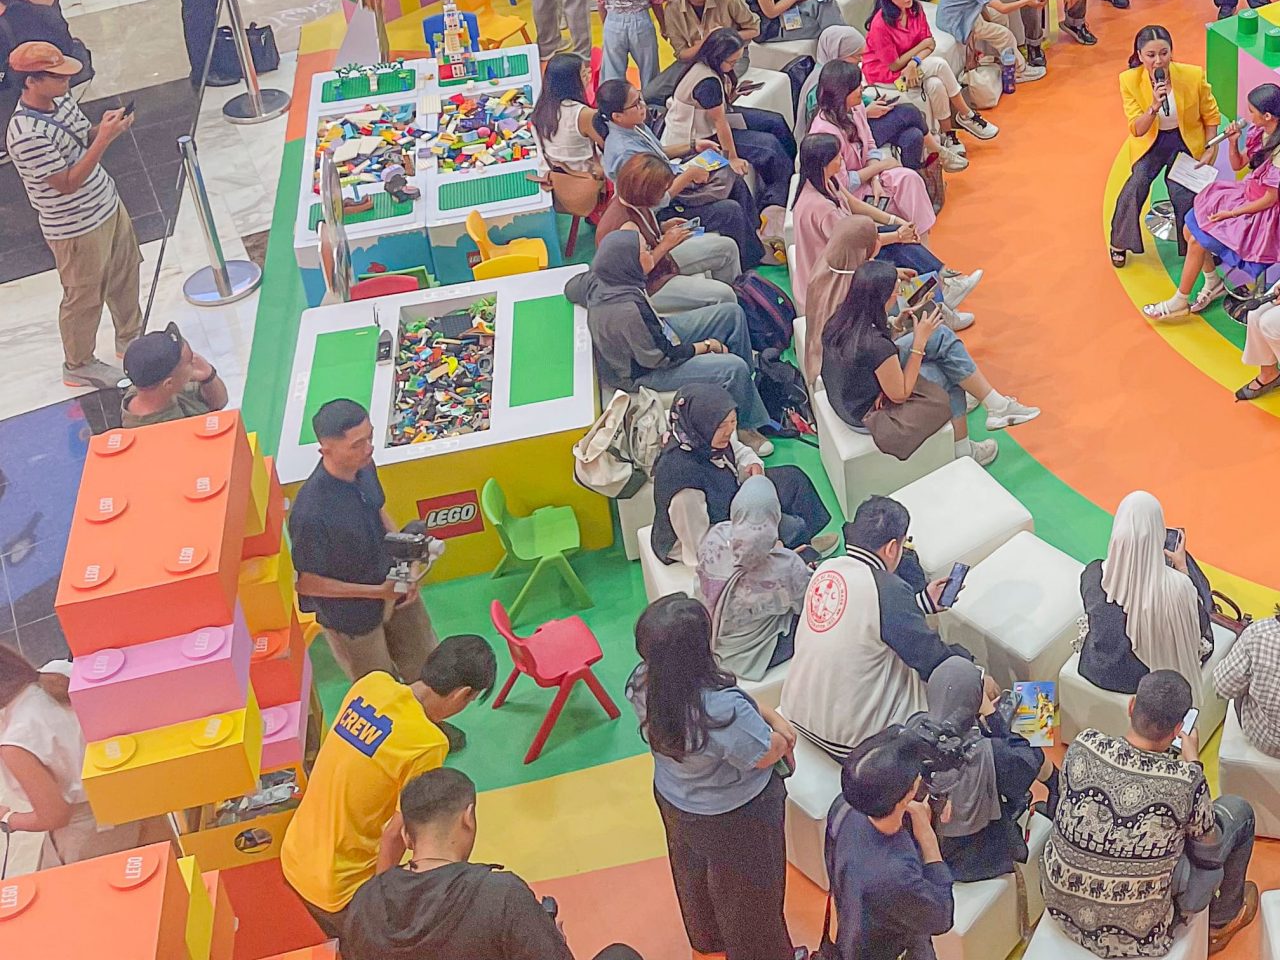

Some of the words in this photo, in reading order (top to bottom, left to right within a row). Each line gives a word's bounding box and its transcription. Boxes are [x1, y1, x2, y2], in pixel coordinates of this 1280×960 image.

[426, 503, 477, 529] LEGO
[339, 707, 383, 746] CREW
[124, 855, 144, 880] LEGO
